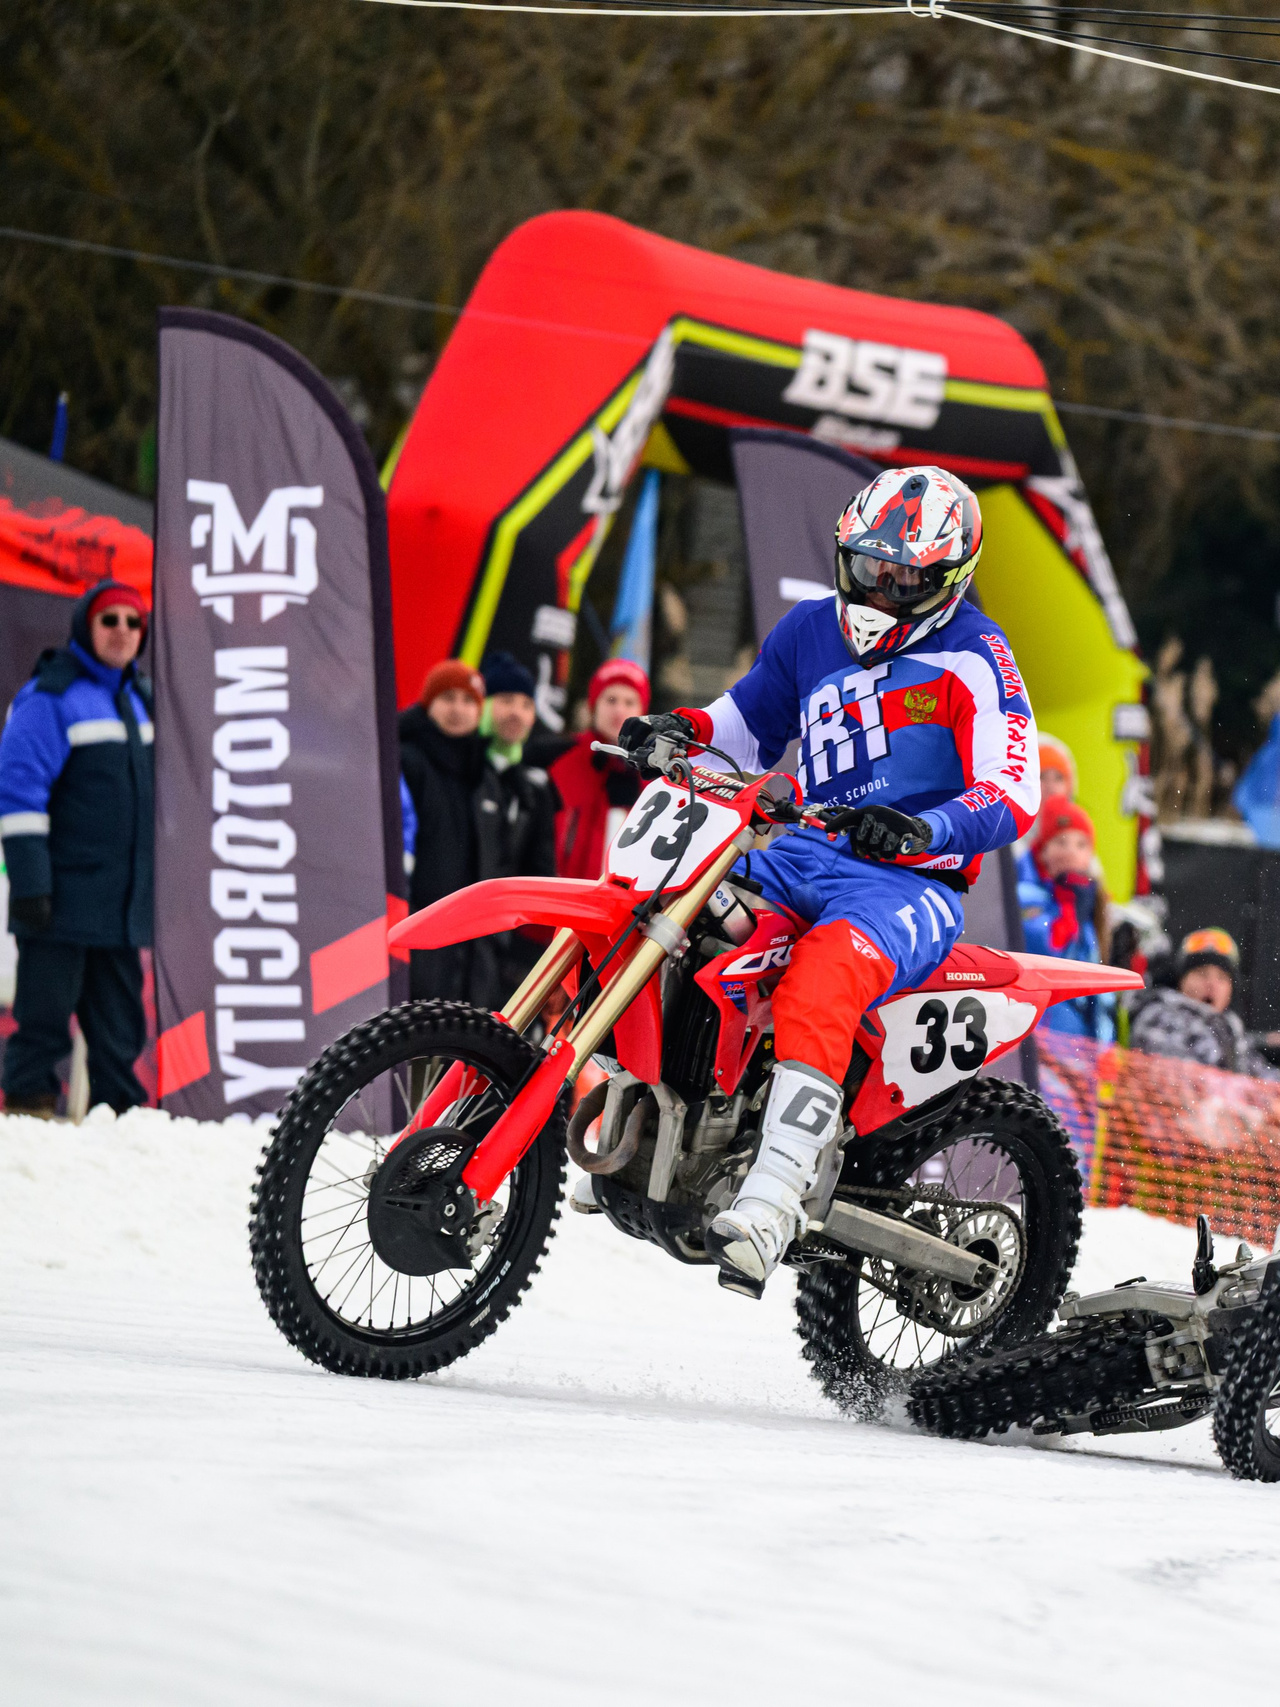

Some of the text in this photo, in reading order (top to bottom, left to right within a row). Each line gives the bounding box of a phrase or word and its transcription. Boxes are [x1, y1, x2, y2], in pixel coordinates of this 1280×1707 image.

[781, 327, 949, 431] BSE
[979, 632, 1026, 704] SHARK
[999, 710, 1029, 783] RACIN
[845, 776, 890, 802] SCHOOL
[617, 790, 710, 861] 33
[721, 944, 798, 976] CR
[945, 971, 987, 982] HONDA
[910, 996, 988, 1074] 33
